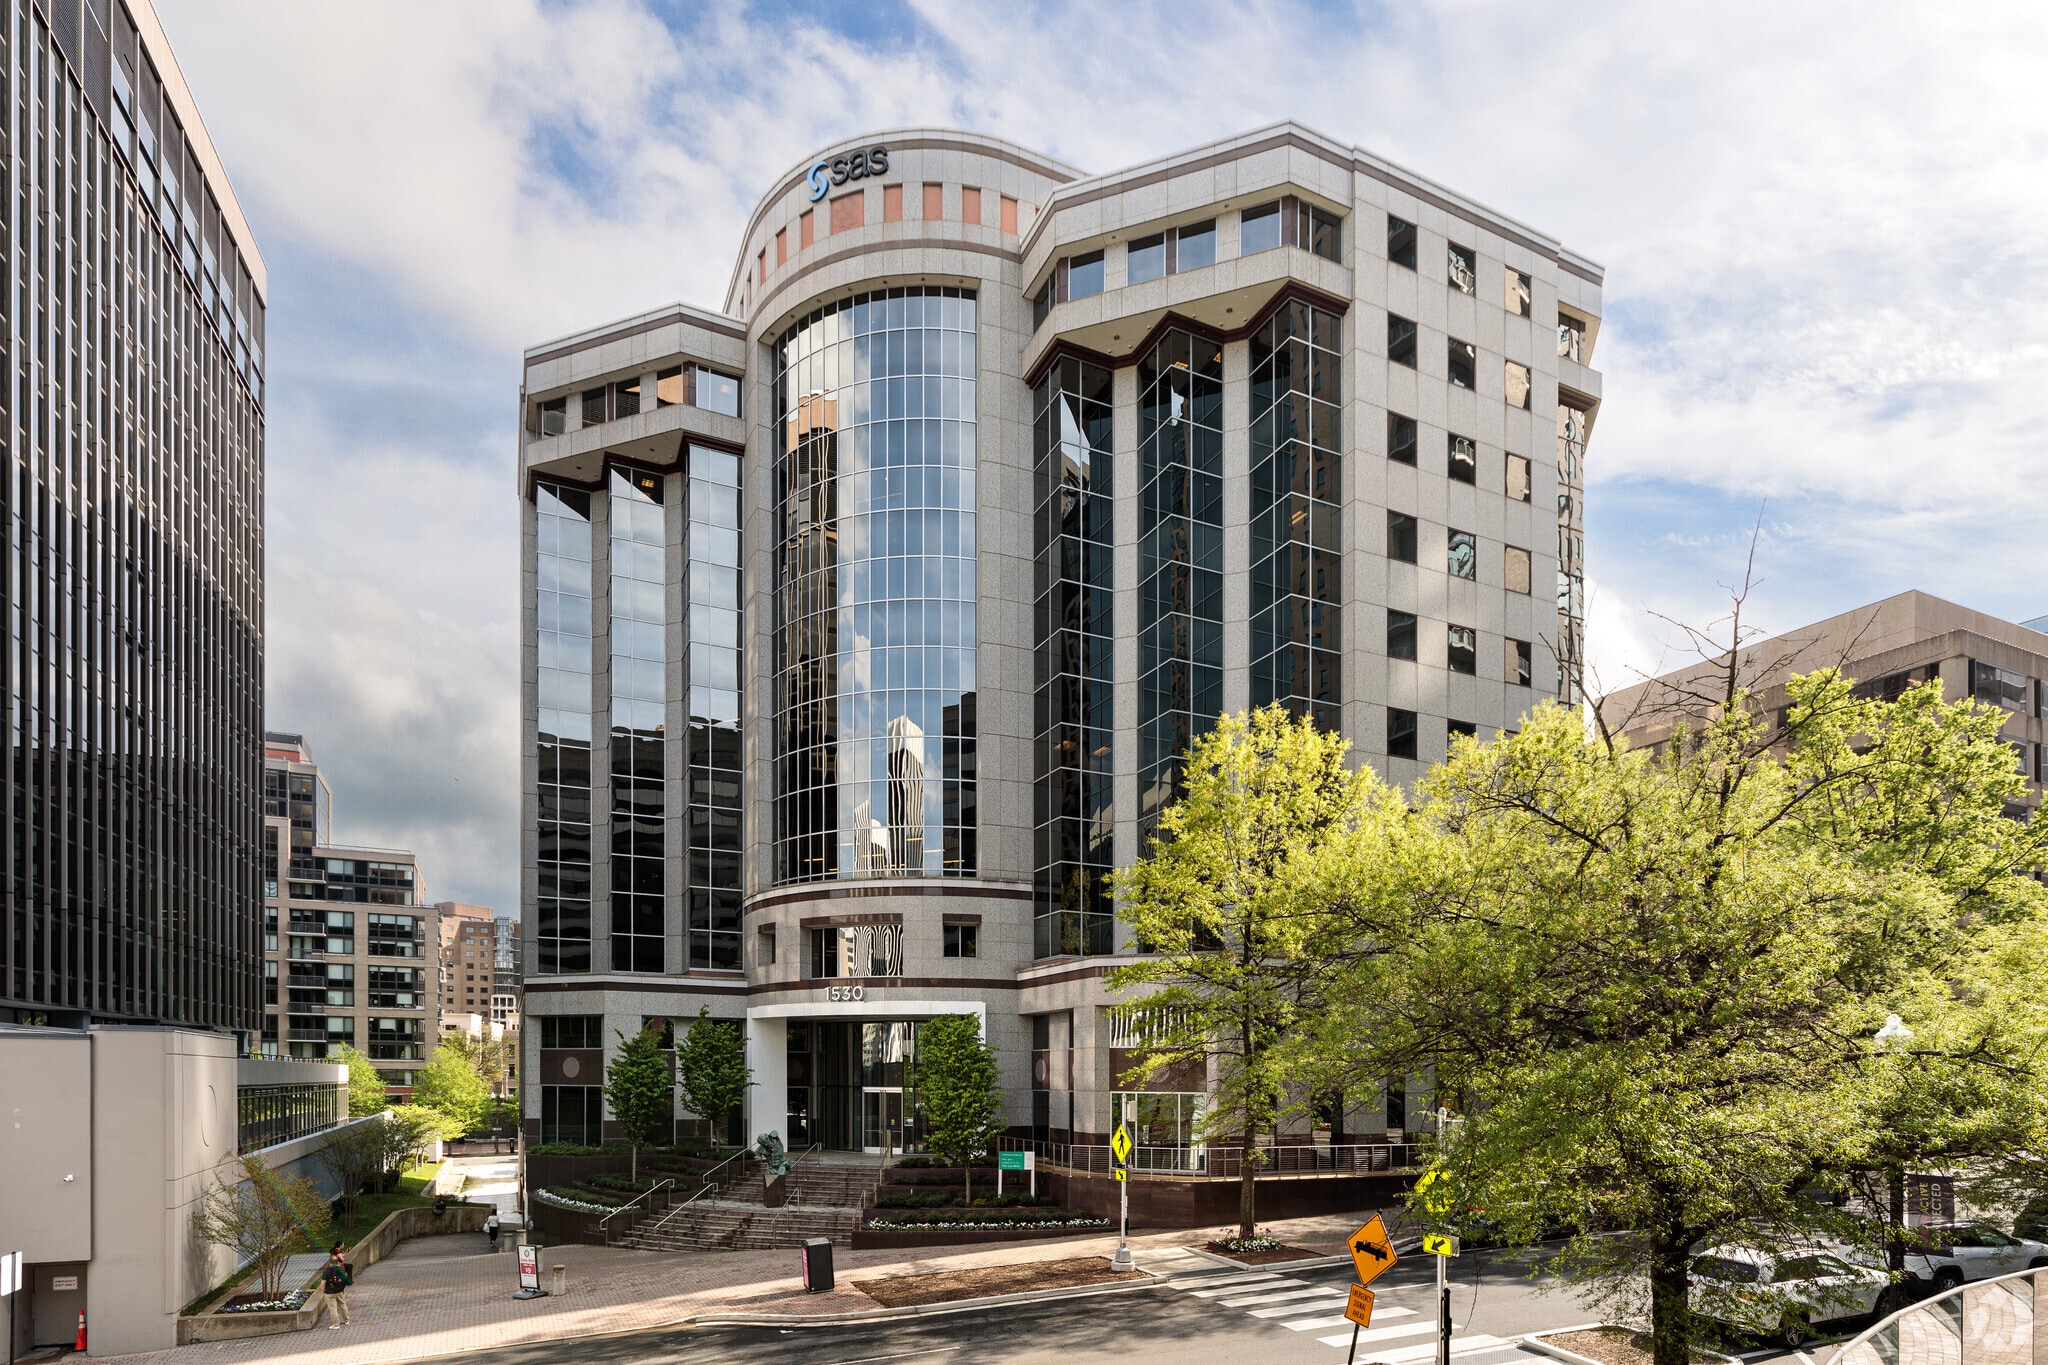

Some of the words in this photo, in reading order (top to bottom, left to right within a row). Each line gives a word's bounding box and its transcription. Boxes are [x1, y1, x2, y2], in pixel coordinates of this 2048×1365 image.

[831, 146, 889, 186] sas
[824, 985, 863, 1000] 1530
[1352, 1289, 1372, 1302] EMERGENCY
[1353, 1299, 1367, 1311] SIGNAL
[1352, 1309, 1365, 1320] AHEAD
